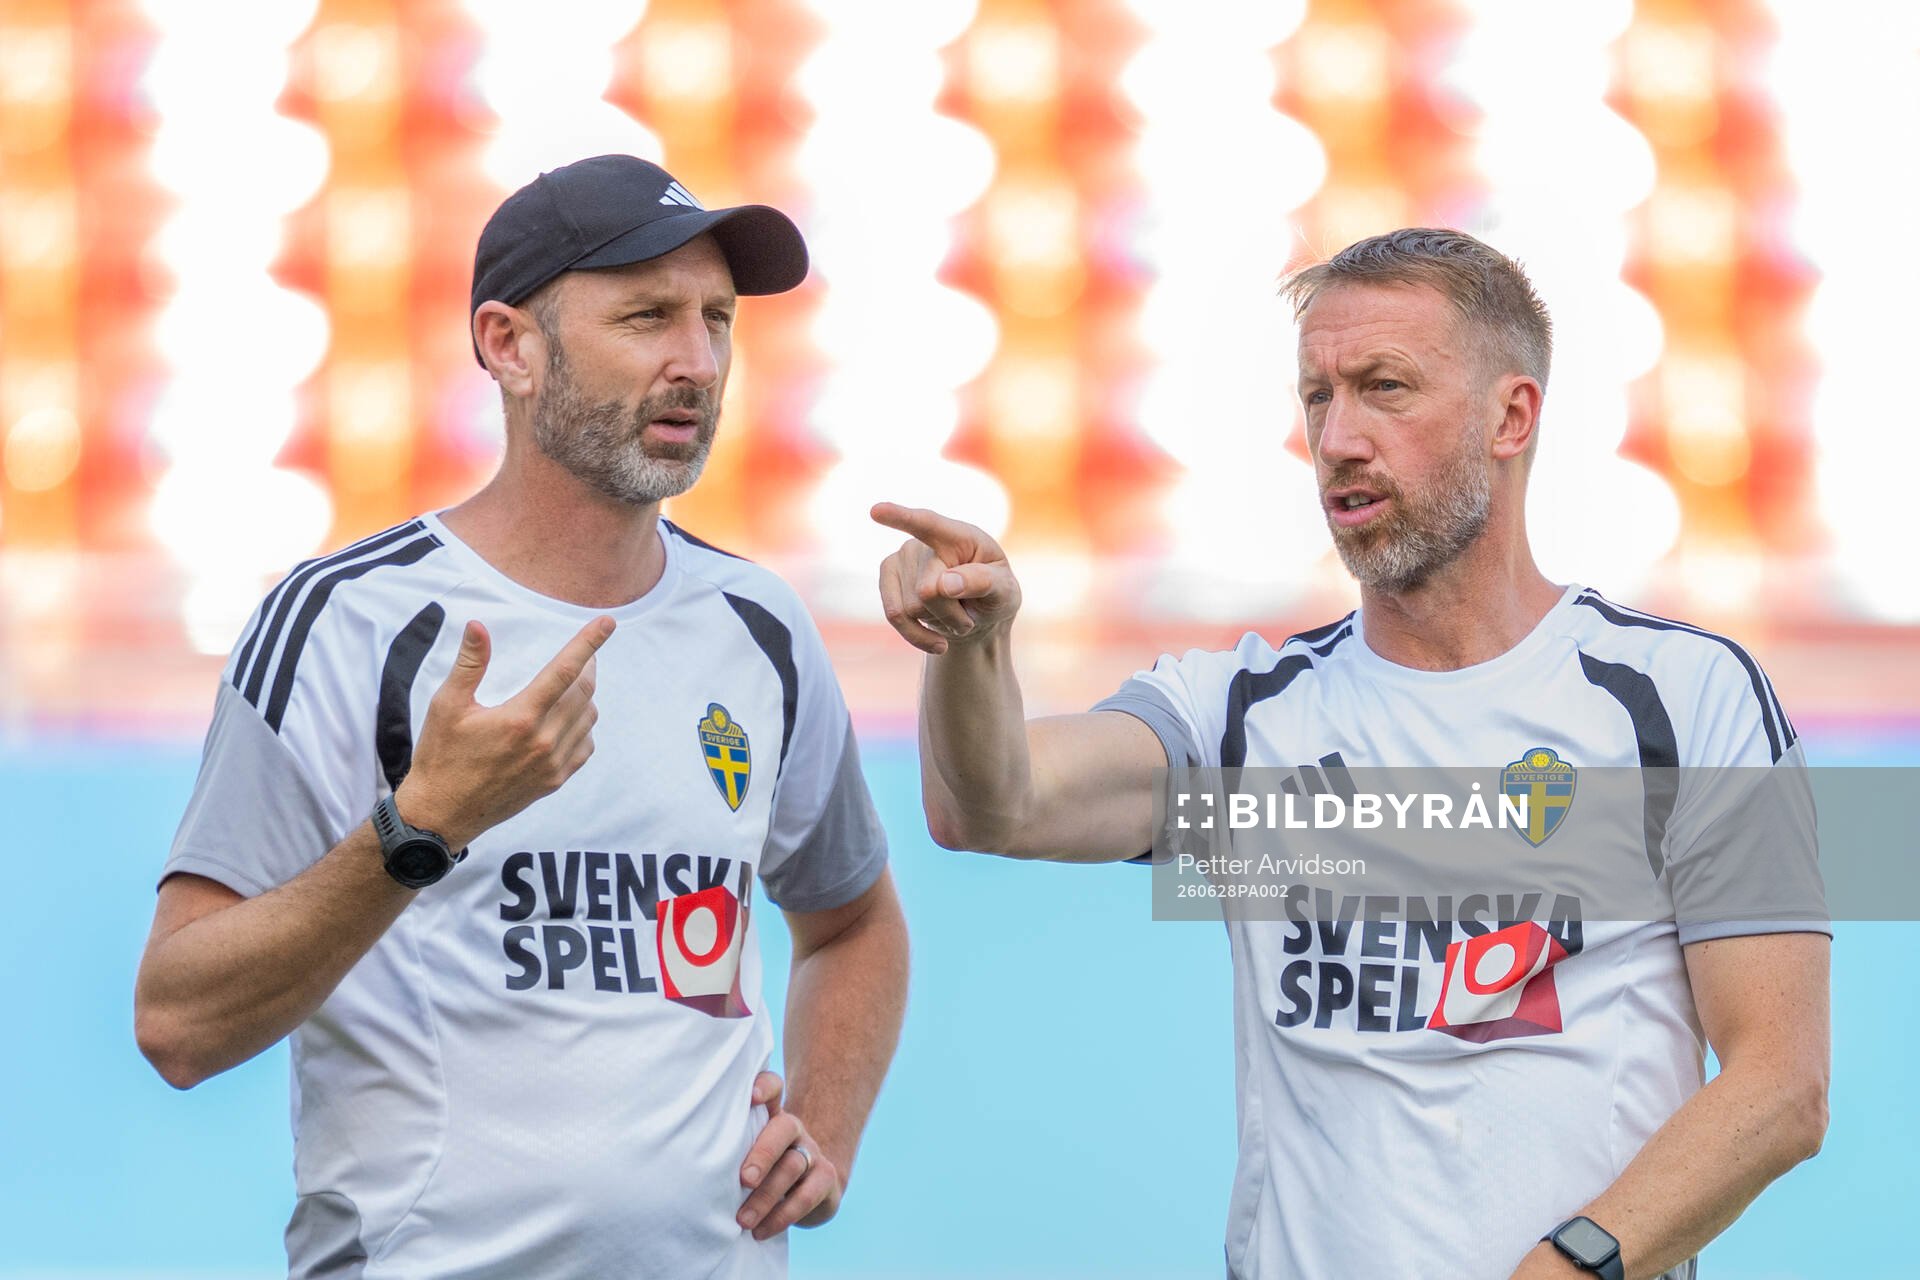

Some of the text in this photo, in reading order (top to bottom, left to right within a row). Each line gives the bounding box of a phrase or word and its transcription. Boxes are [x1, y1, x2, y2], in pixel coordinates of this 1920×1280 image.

[705, 733, 741, 746] SVERIGE
[1513, 773, 1565, 781] SVERIGE
[502, 924, 658, 993] SPEL
[1275, 959, 1429, 1033] SPEL
